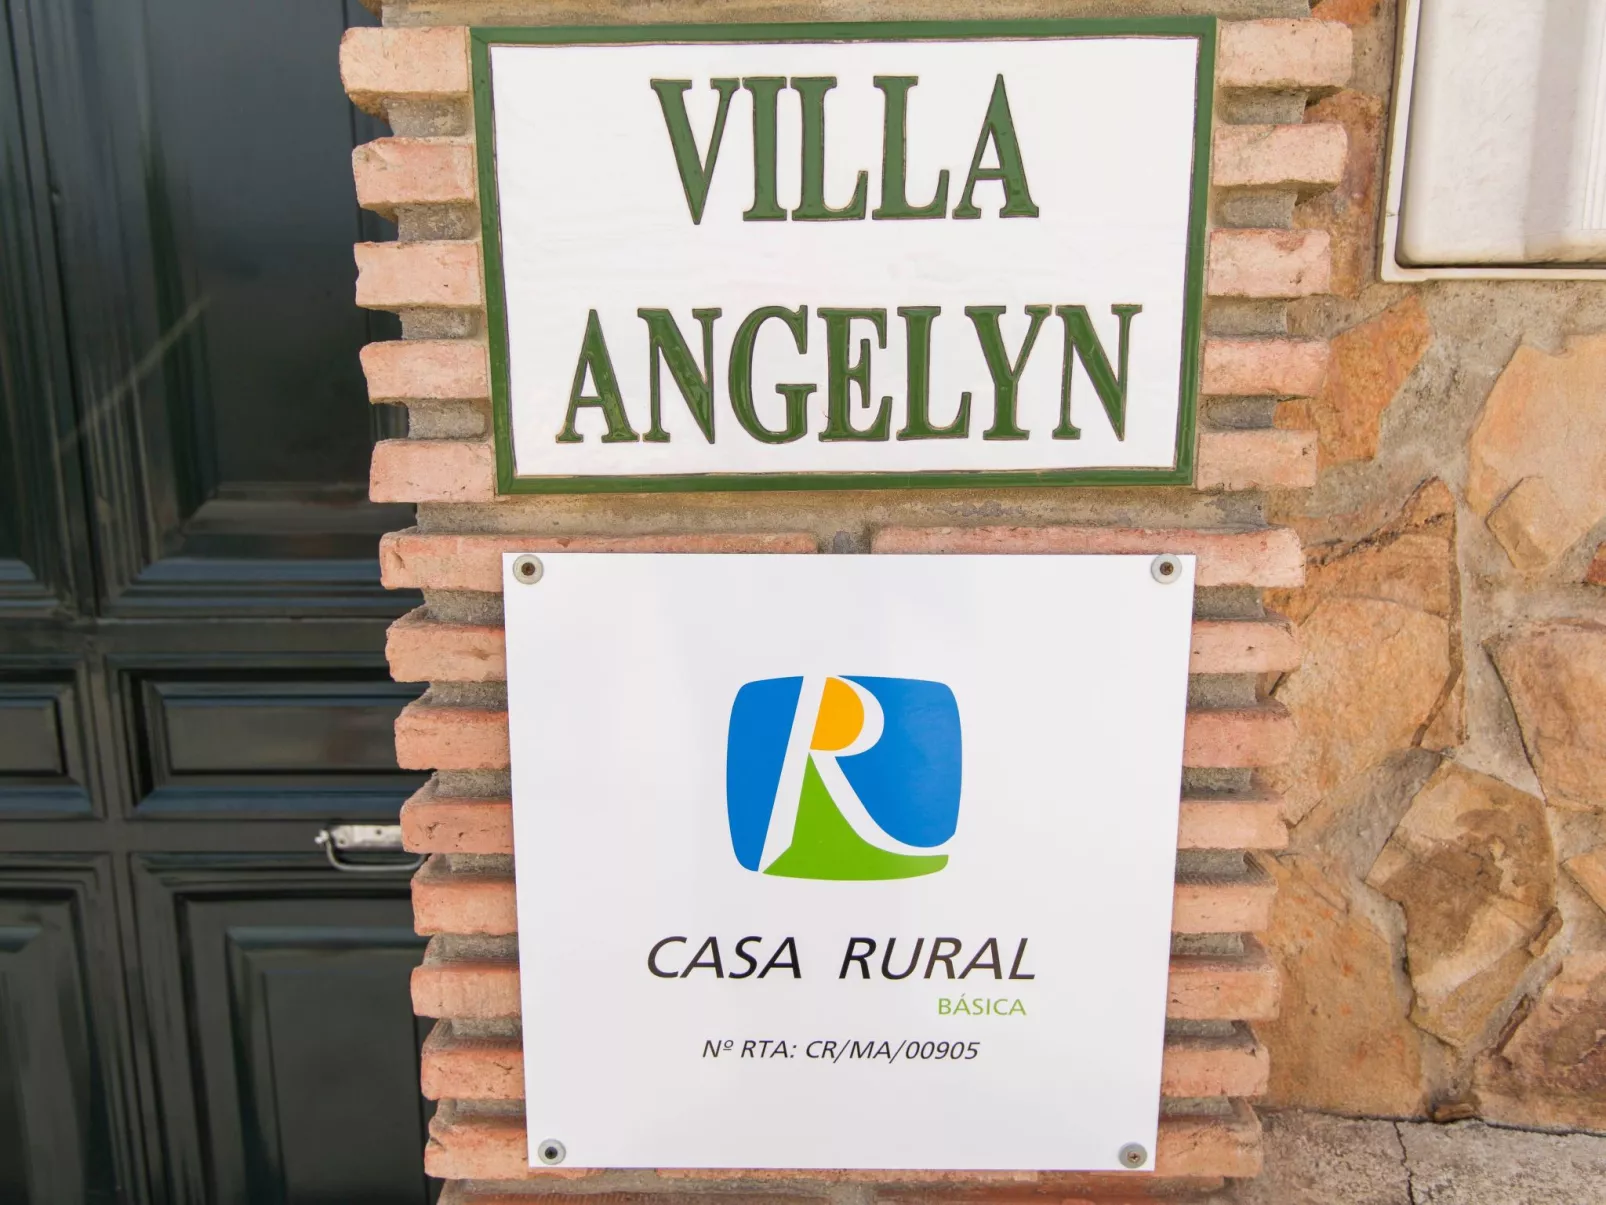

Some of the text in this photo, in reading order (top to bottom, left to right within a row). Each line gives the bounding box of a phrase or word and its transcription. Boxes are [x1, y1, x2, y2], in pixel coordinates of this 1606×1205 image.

[649, 73, 1040, 226] VILLA
[555, 303, 1143, 445] ANGELYN
[647, 935, 1036, 981] CASA RURAL
[937, 993, 1027, 1016] BÁSICA
[740, 1039, 797, 1060] RTA:
[805, 1039, 981, 1064] CR/MA/00905
